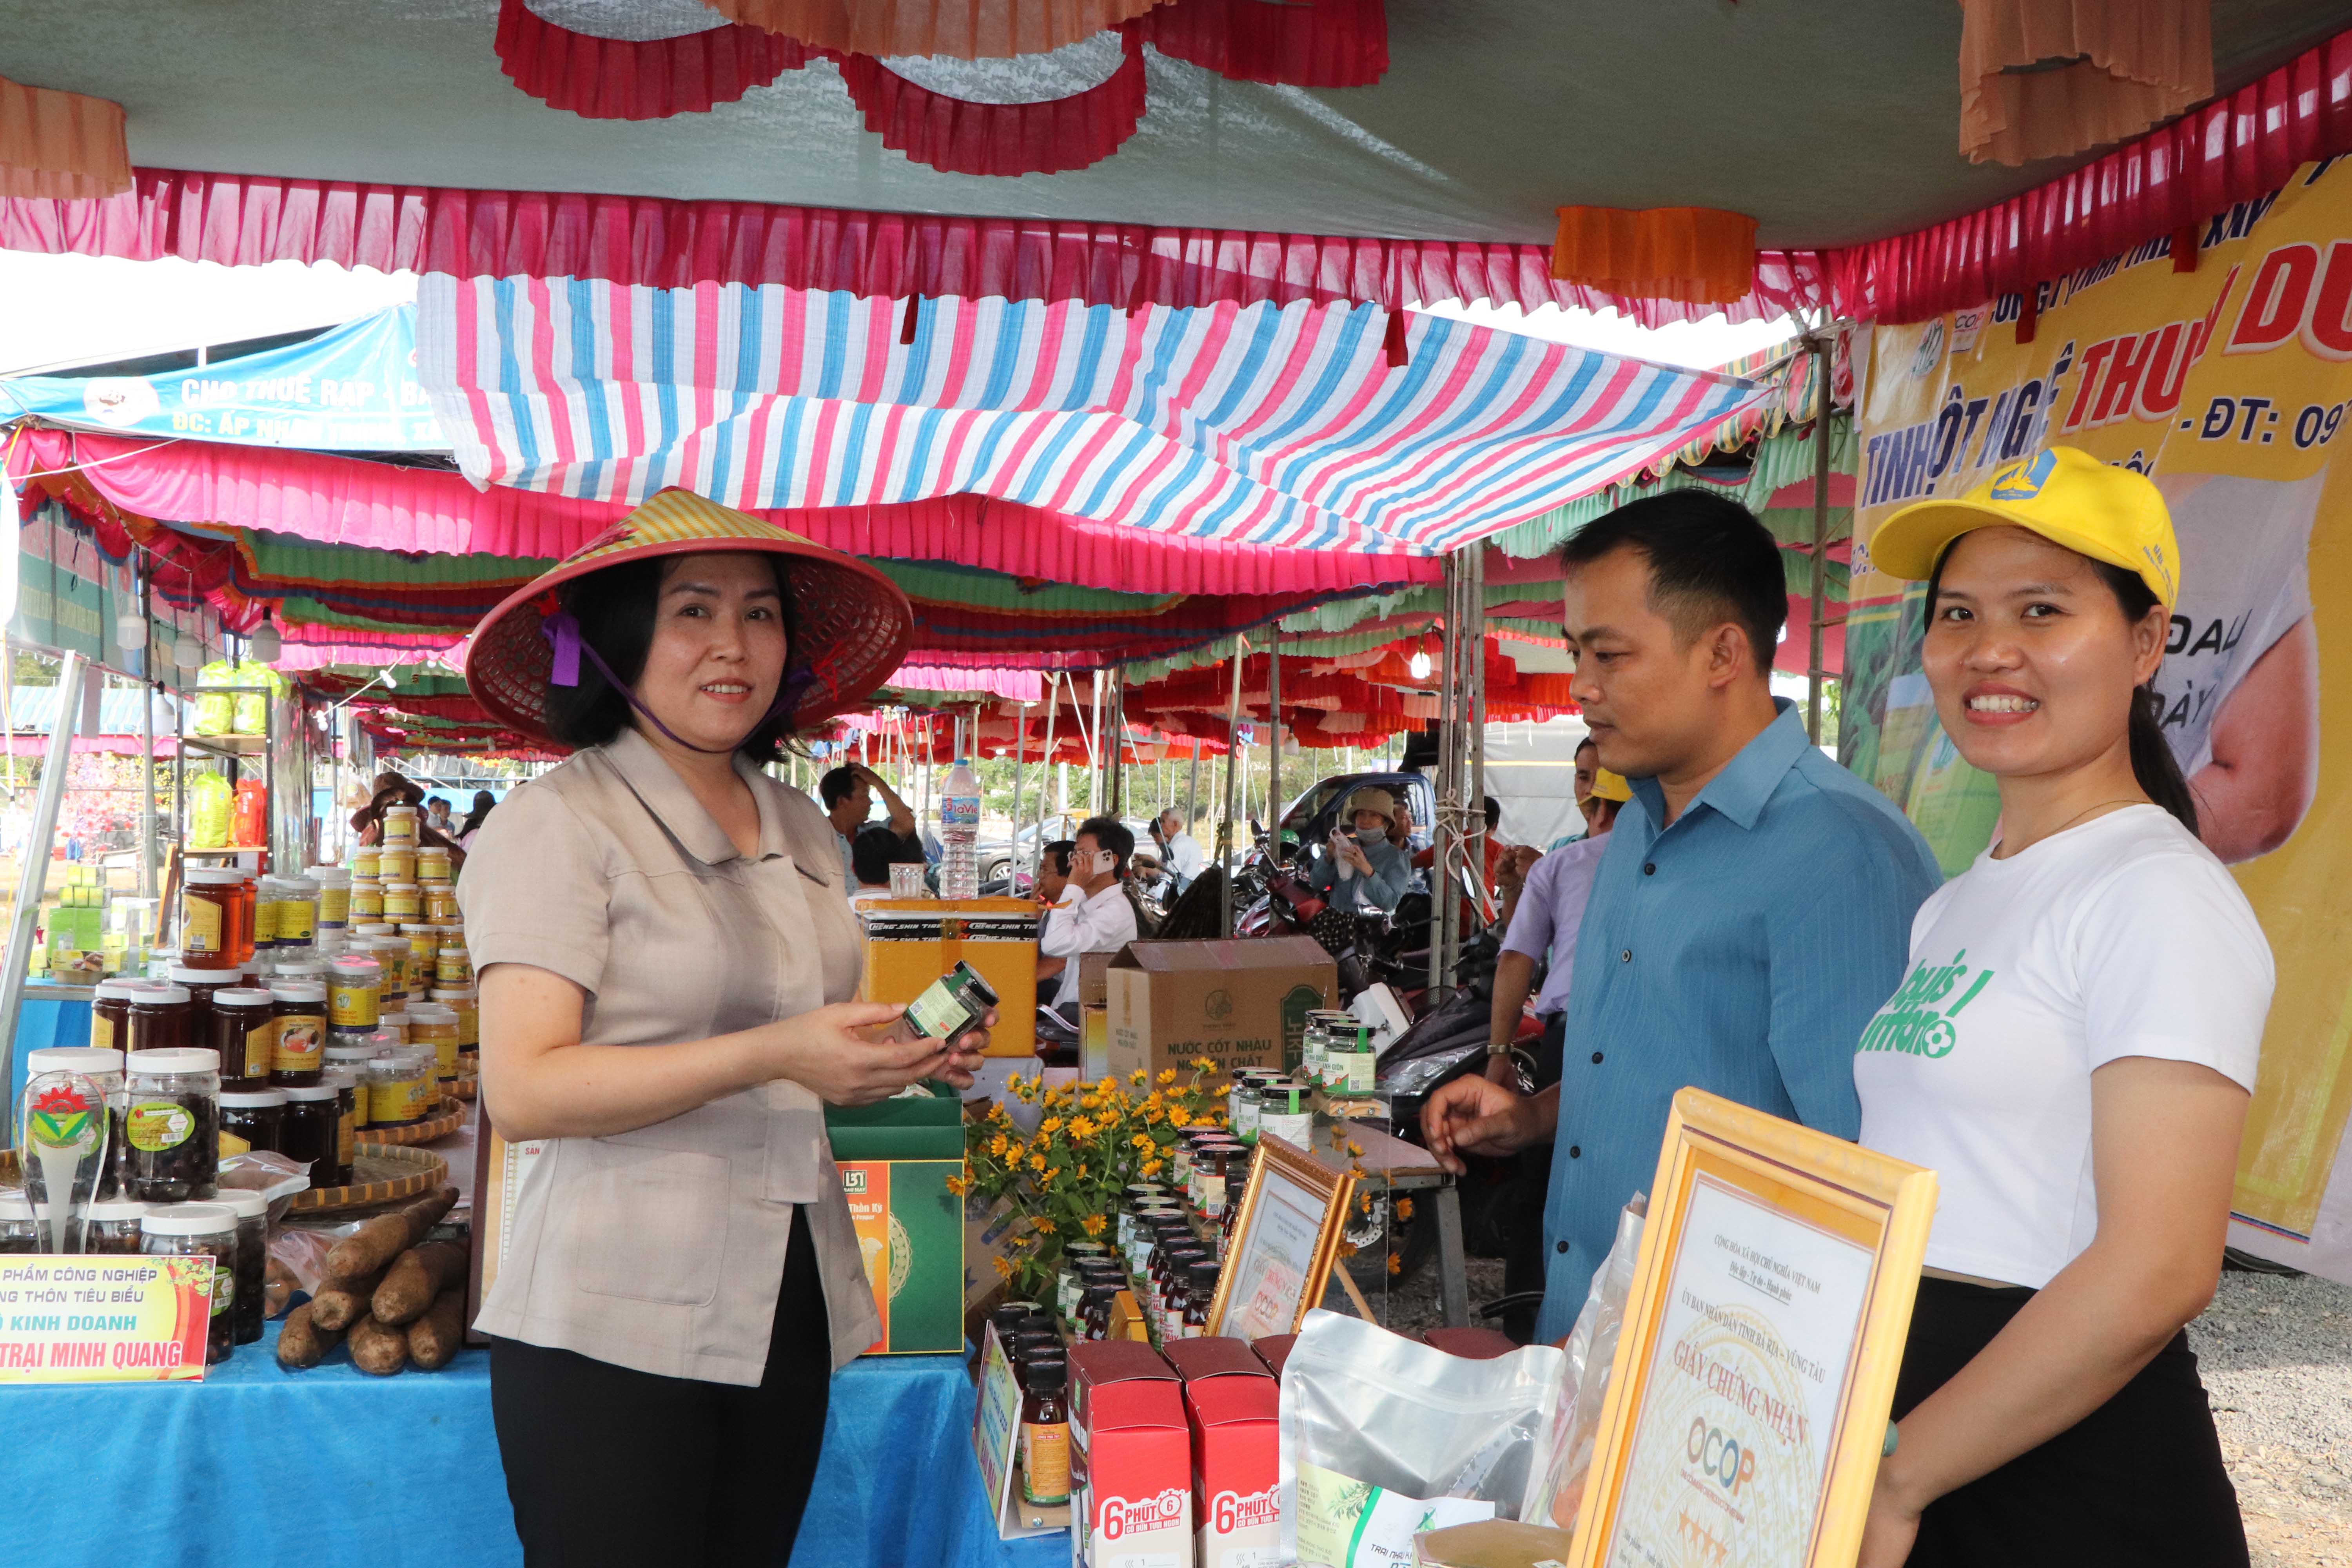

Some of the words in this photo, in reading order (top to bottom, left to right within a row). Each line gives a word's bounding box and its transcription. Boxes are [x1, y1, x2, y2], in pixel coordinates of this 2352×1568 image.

[181, 378, 237, 407] CHO
[172, 411, 211, 432] ĐC:
[2201, 397, 2278, 443] ĐT:
[2294, 399, 2352, 448] 09
[953, 804, 978, 814] laVie
[525, 1143, 540, 1155] SẢN
[3, 1263, 48, 1281] PHẨM
[53, 1267, 97, 1281] CÔNG
[102, 1267, 157, 1285] NGHIỆP
[25, 1288, 67, 1303] THÔN
[73, 1287, 107, 1303] TIÊU
[111, 1284, 144, 1303] BIỂU
[10, 1316, 61, 1331] KINH
[67, 1315, 137, 1331] DOANH
[0, 1342, 45, 1373] TRẠI
[50, 1342, 107, 1368] MINH
[112, 1341, 182, 1370] QUANG
[1674, 1338, 1709, 1381] GIẤY
[1708, 1362, 1761, 1417] CHỨNG
[1759, 1392, 1809, 1448] NHẬN
[1687, 1416, 1755, 1497] OCOP
[1103, 1500, 1124, 1541] 6
[1215, 1495, 1236, 1535] 6
